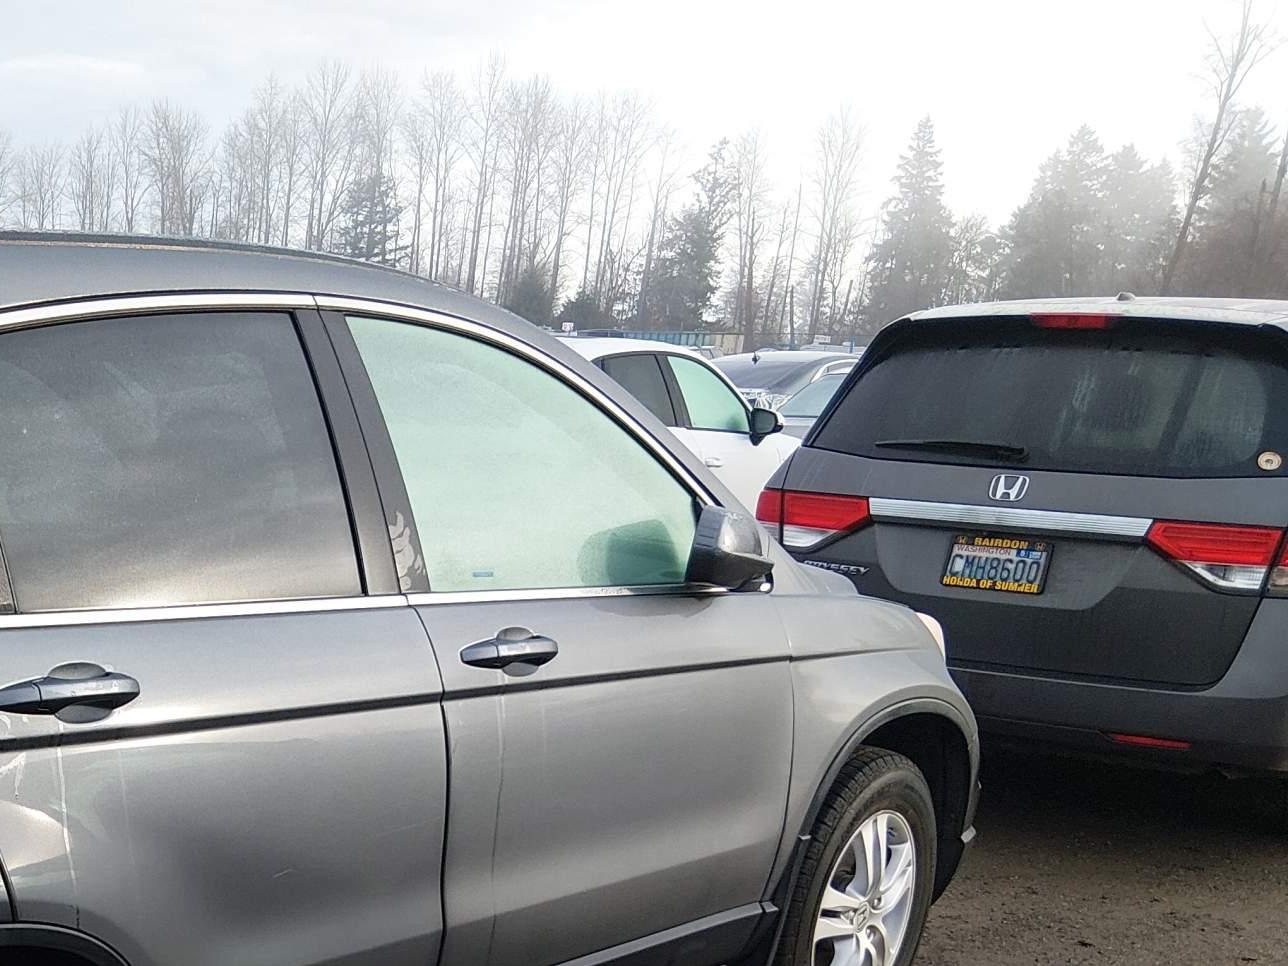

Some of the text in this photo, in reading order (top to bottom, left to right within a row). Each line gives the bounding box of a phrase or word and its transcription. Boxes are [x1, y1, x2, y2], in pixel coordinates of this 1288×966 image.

[957, 545, 1011, 556] WASHINGTON
[949, 553, 1041, 584] CMH8600
[942, 575, 976, 588] HONDA
[979, 579, 993, 589] OF
